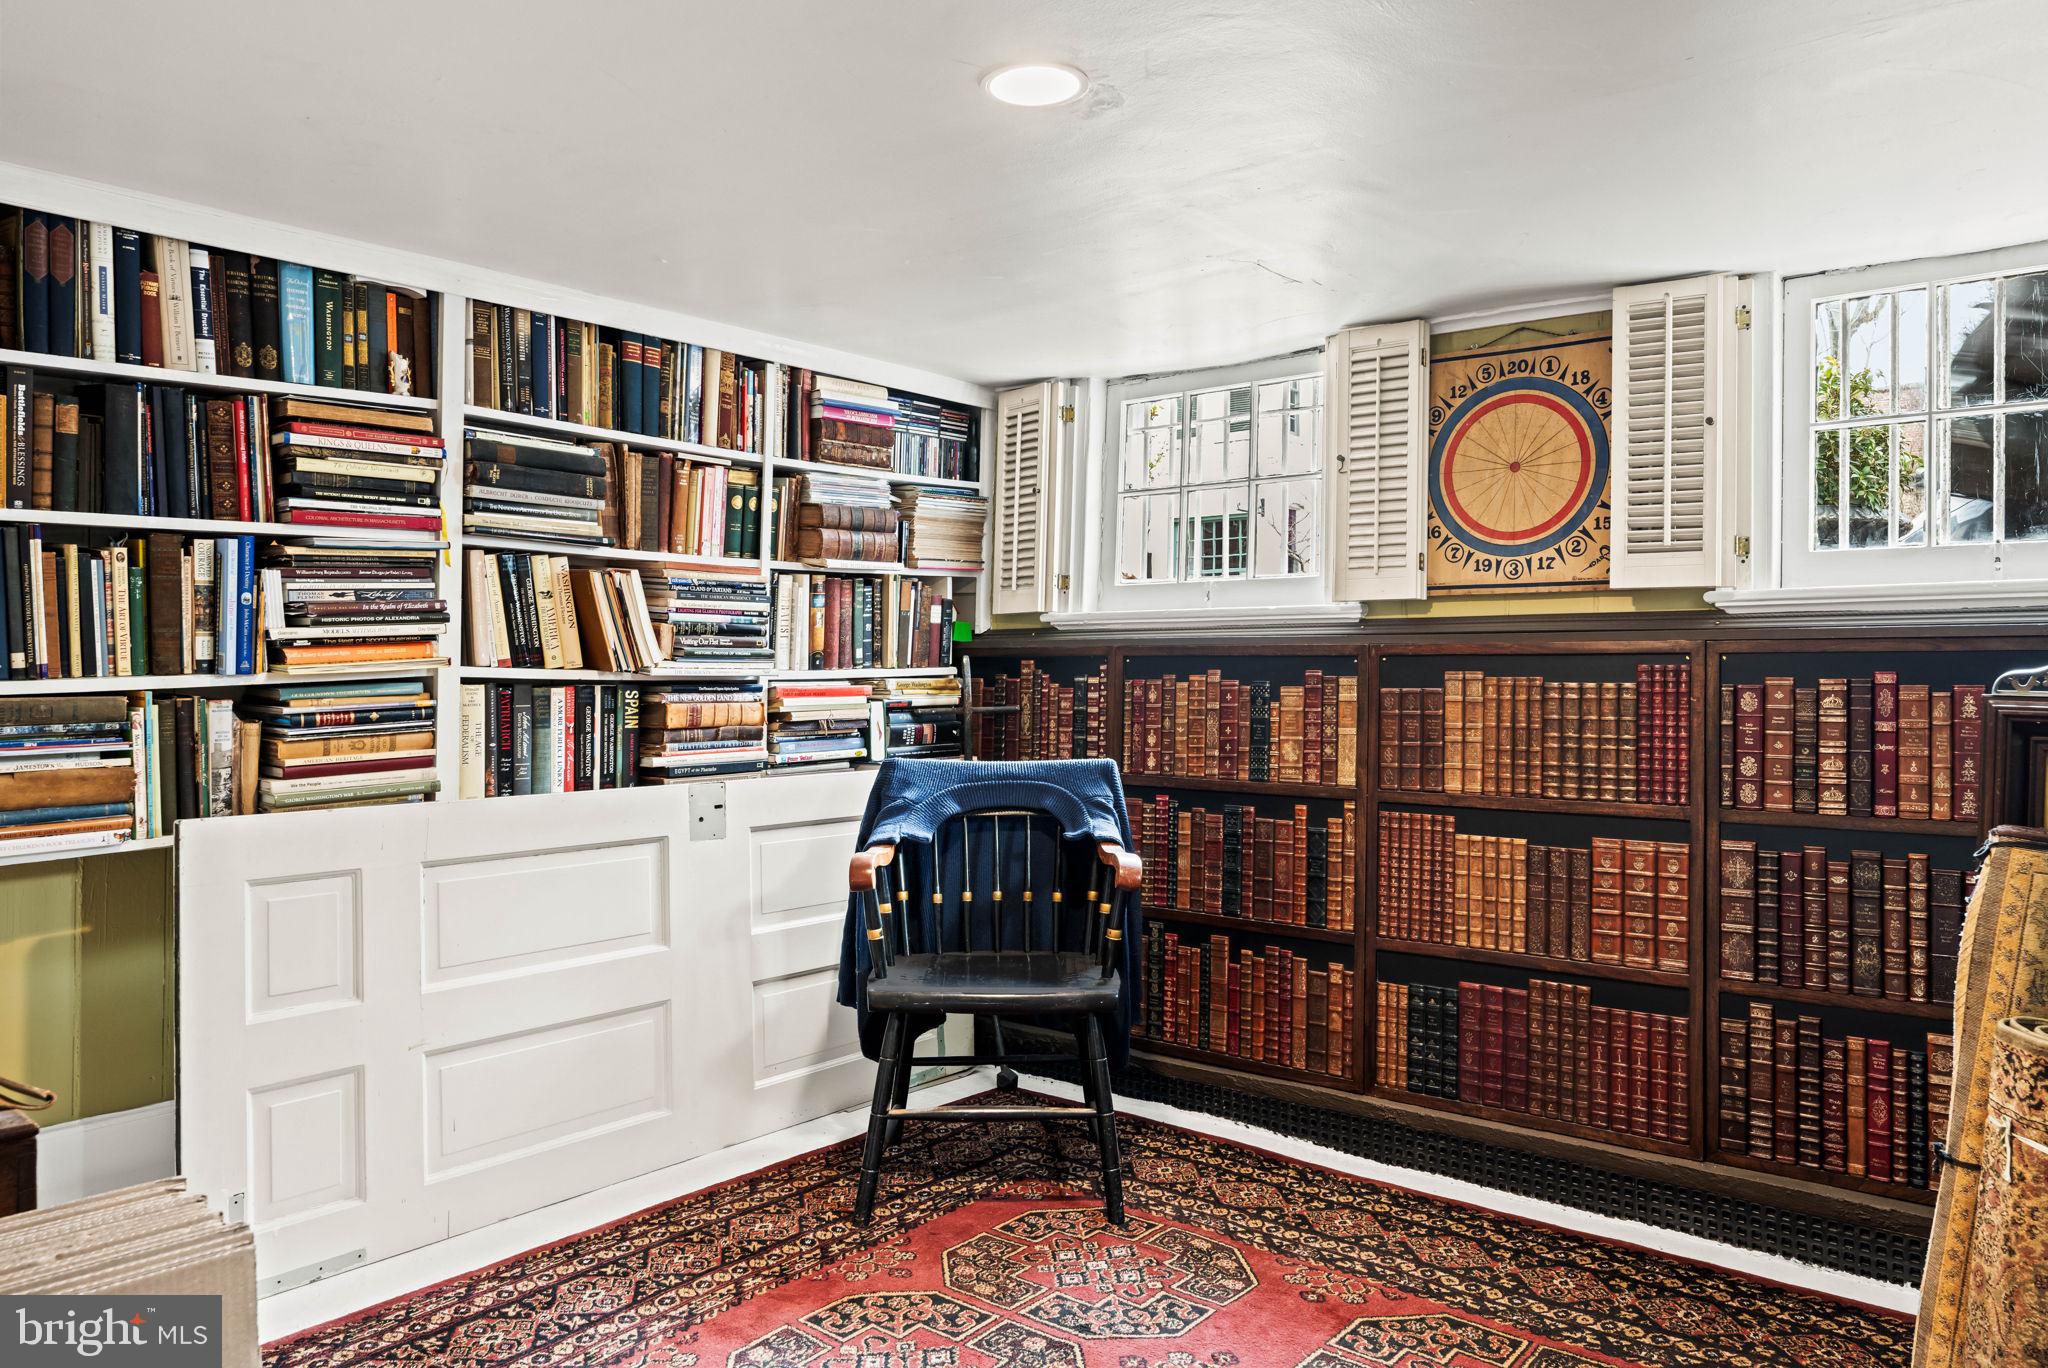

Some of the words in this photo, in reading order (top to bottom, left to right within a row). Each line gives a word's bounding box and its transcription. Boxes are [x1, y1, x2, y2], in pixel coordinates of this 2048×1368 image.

[200, 283, 208, 311] Essential
[325, 302, 334, 350] WASHINGTON
[1507, 360, 1528, 374] 20
[1546, 359, 1554, 372] 1
[1482, 367, 1492, 380] 5
[1571, 370, 1591, 386] 18
[1450, 386, 1468, 398] 12
[1598, 391, 1608, 404] 4
[18, 384, 26, 436] Battlefields
[1432, 409, 1441, 422] 9
[318, 438, 344, 448] KINGS
[346, 440, 352, 448] &
[354, 441, 388, 452] QUEENS
[18, 442, 26, 486] BLESSINGS
[1594, 516, 1610, 530] 15
[1572, 539, 1582, 552] 2
[198, 542, 206, 578] COURAGE
[1450, 547, 1460, 559] 7
[1474, 559, 1493, 572] 19
[1509, 562, 1519, 576] 3
[1537, 557, 1554, 570] 17
[118, 589, 126, 604] THE
[360, 591, 402, 599] Liberty!
[561, 564, 576, 630] WASHINGTON
[119, 606, 127, 622] ART
[526, 578, 534, 604] GEORGE
[530, 605, 540, 648] WASHINGTON
[120, 623, 127, 631] OF
[515, 602, 526, 644] WASHINGTON
[546, 607, 559, 650] AMERICA
[120, 633, 128, 662] VIRTUE
[680, 638, 698, 646] Visiting
[668, 694, 678, 702] THE
[680, 694, 692, 702] NEW
[692, 694, 716, 702] GOLDEN
[716, 694, 734, 702] LAND
[624, 690, 639, 728] SPAIN
[501, 690, 510, 750] PATRIARCH
[522, 712, 530, 729] John
[306, 794, 342, 802] WASHINGTON'S
